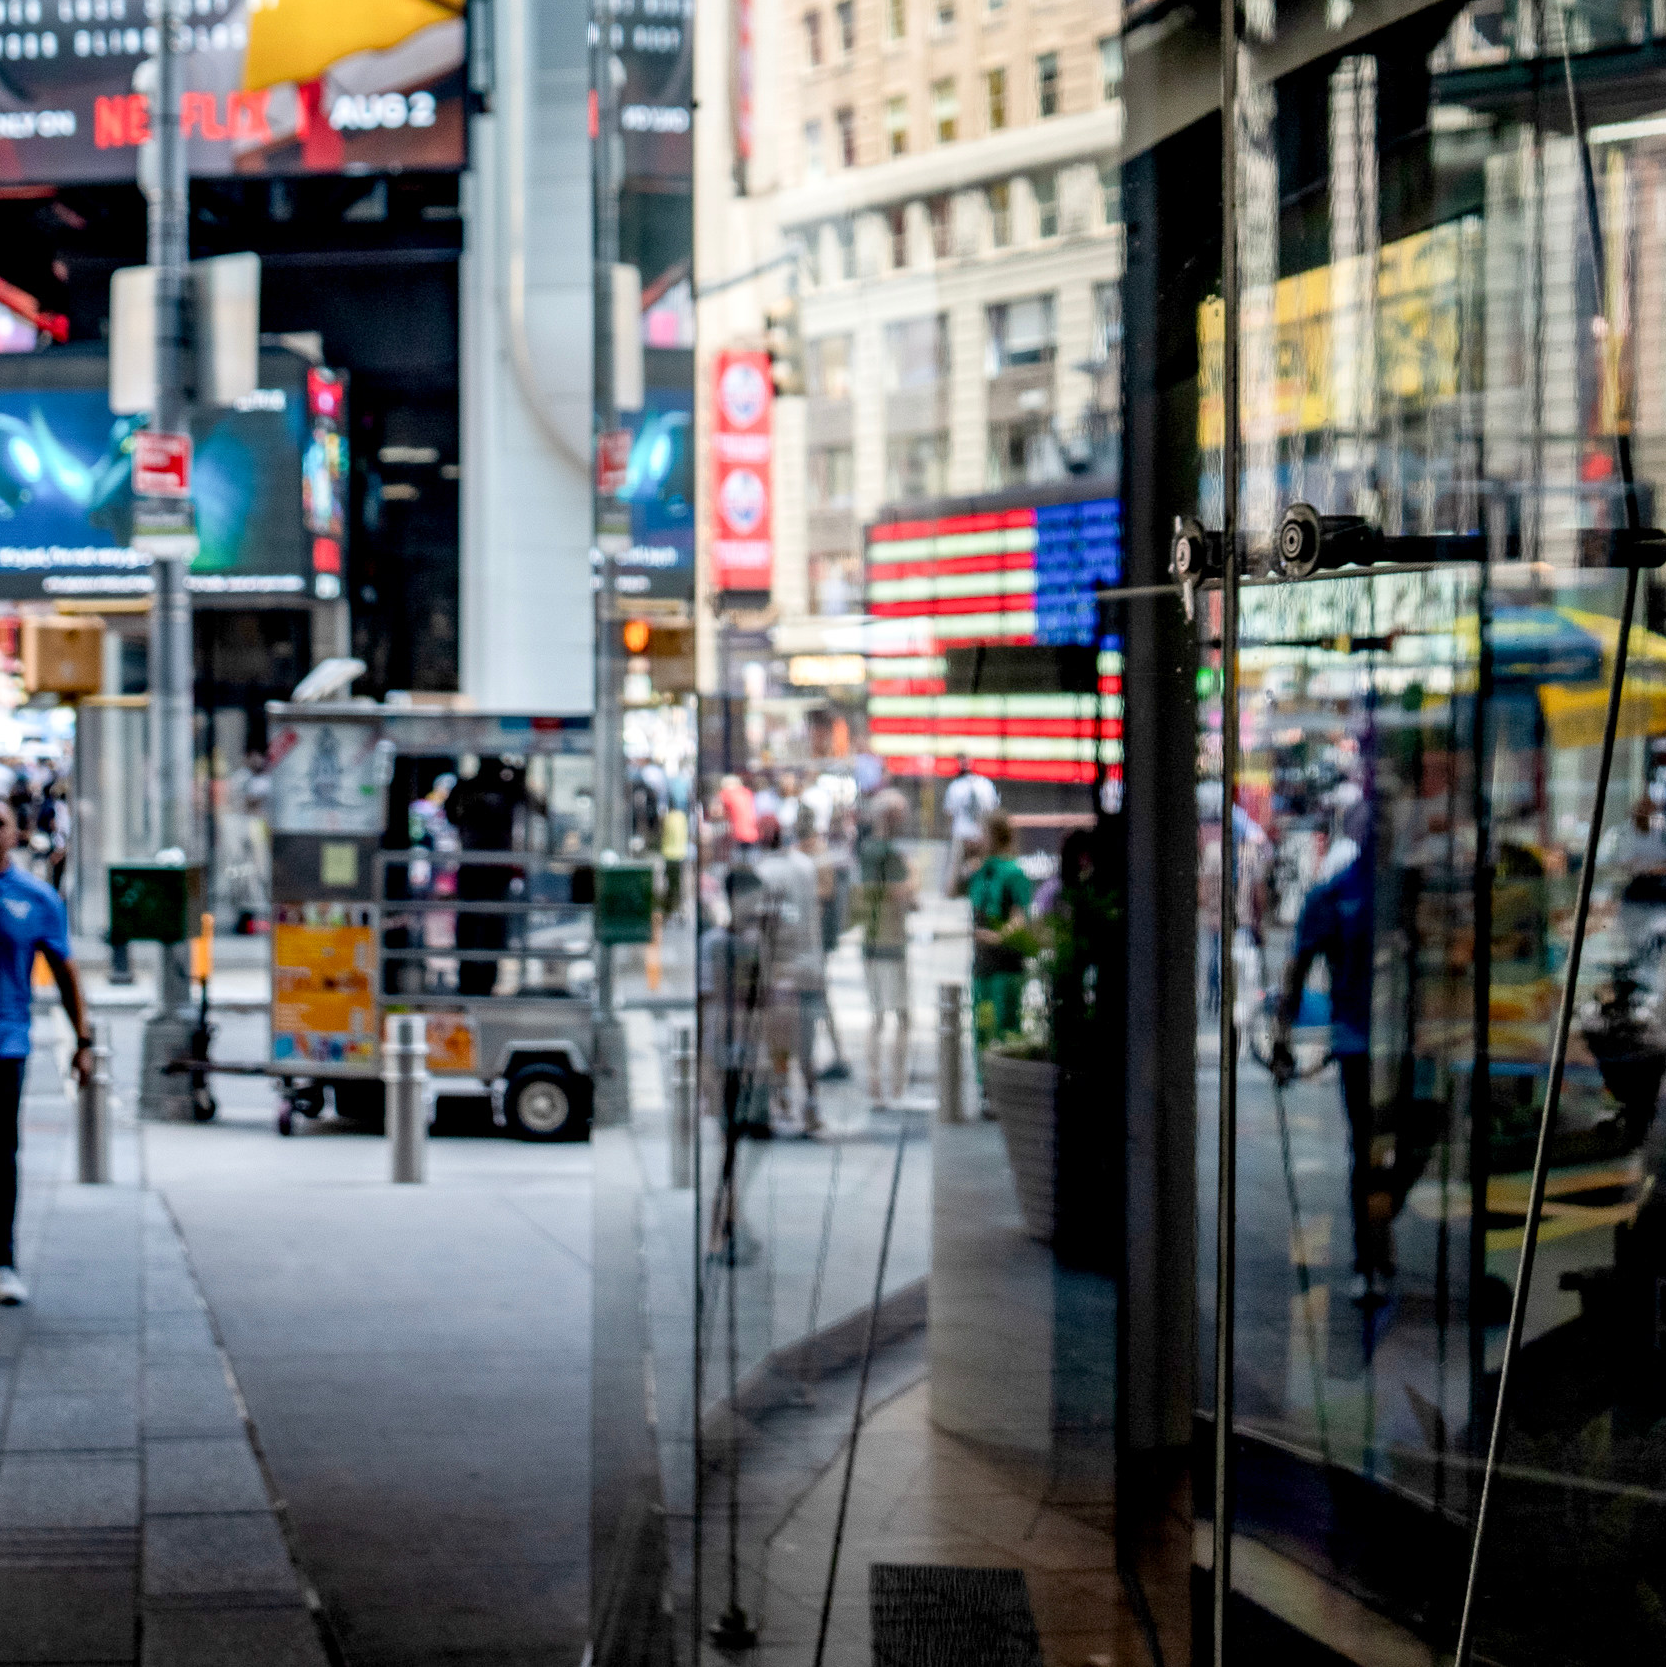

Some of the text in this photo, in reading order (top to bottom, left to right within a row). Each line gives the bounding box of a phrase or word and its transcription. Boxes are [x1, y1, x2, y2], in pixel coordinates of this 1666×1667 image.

[94, 90, 272, 150] NEFLIX
[329, 90, 437, 131] AUG 2
